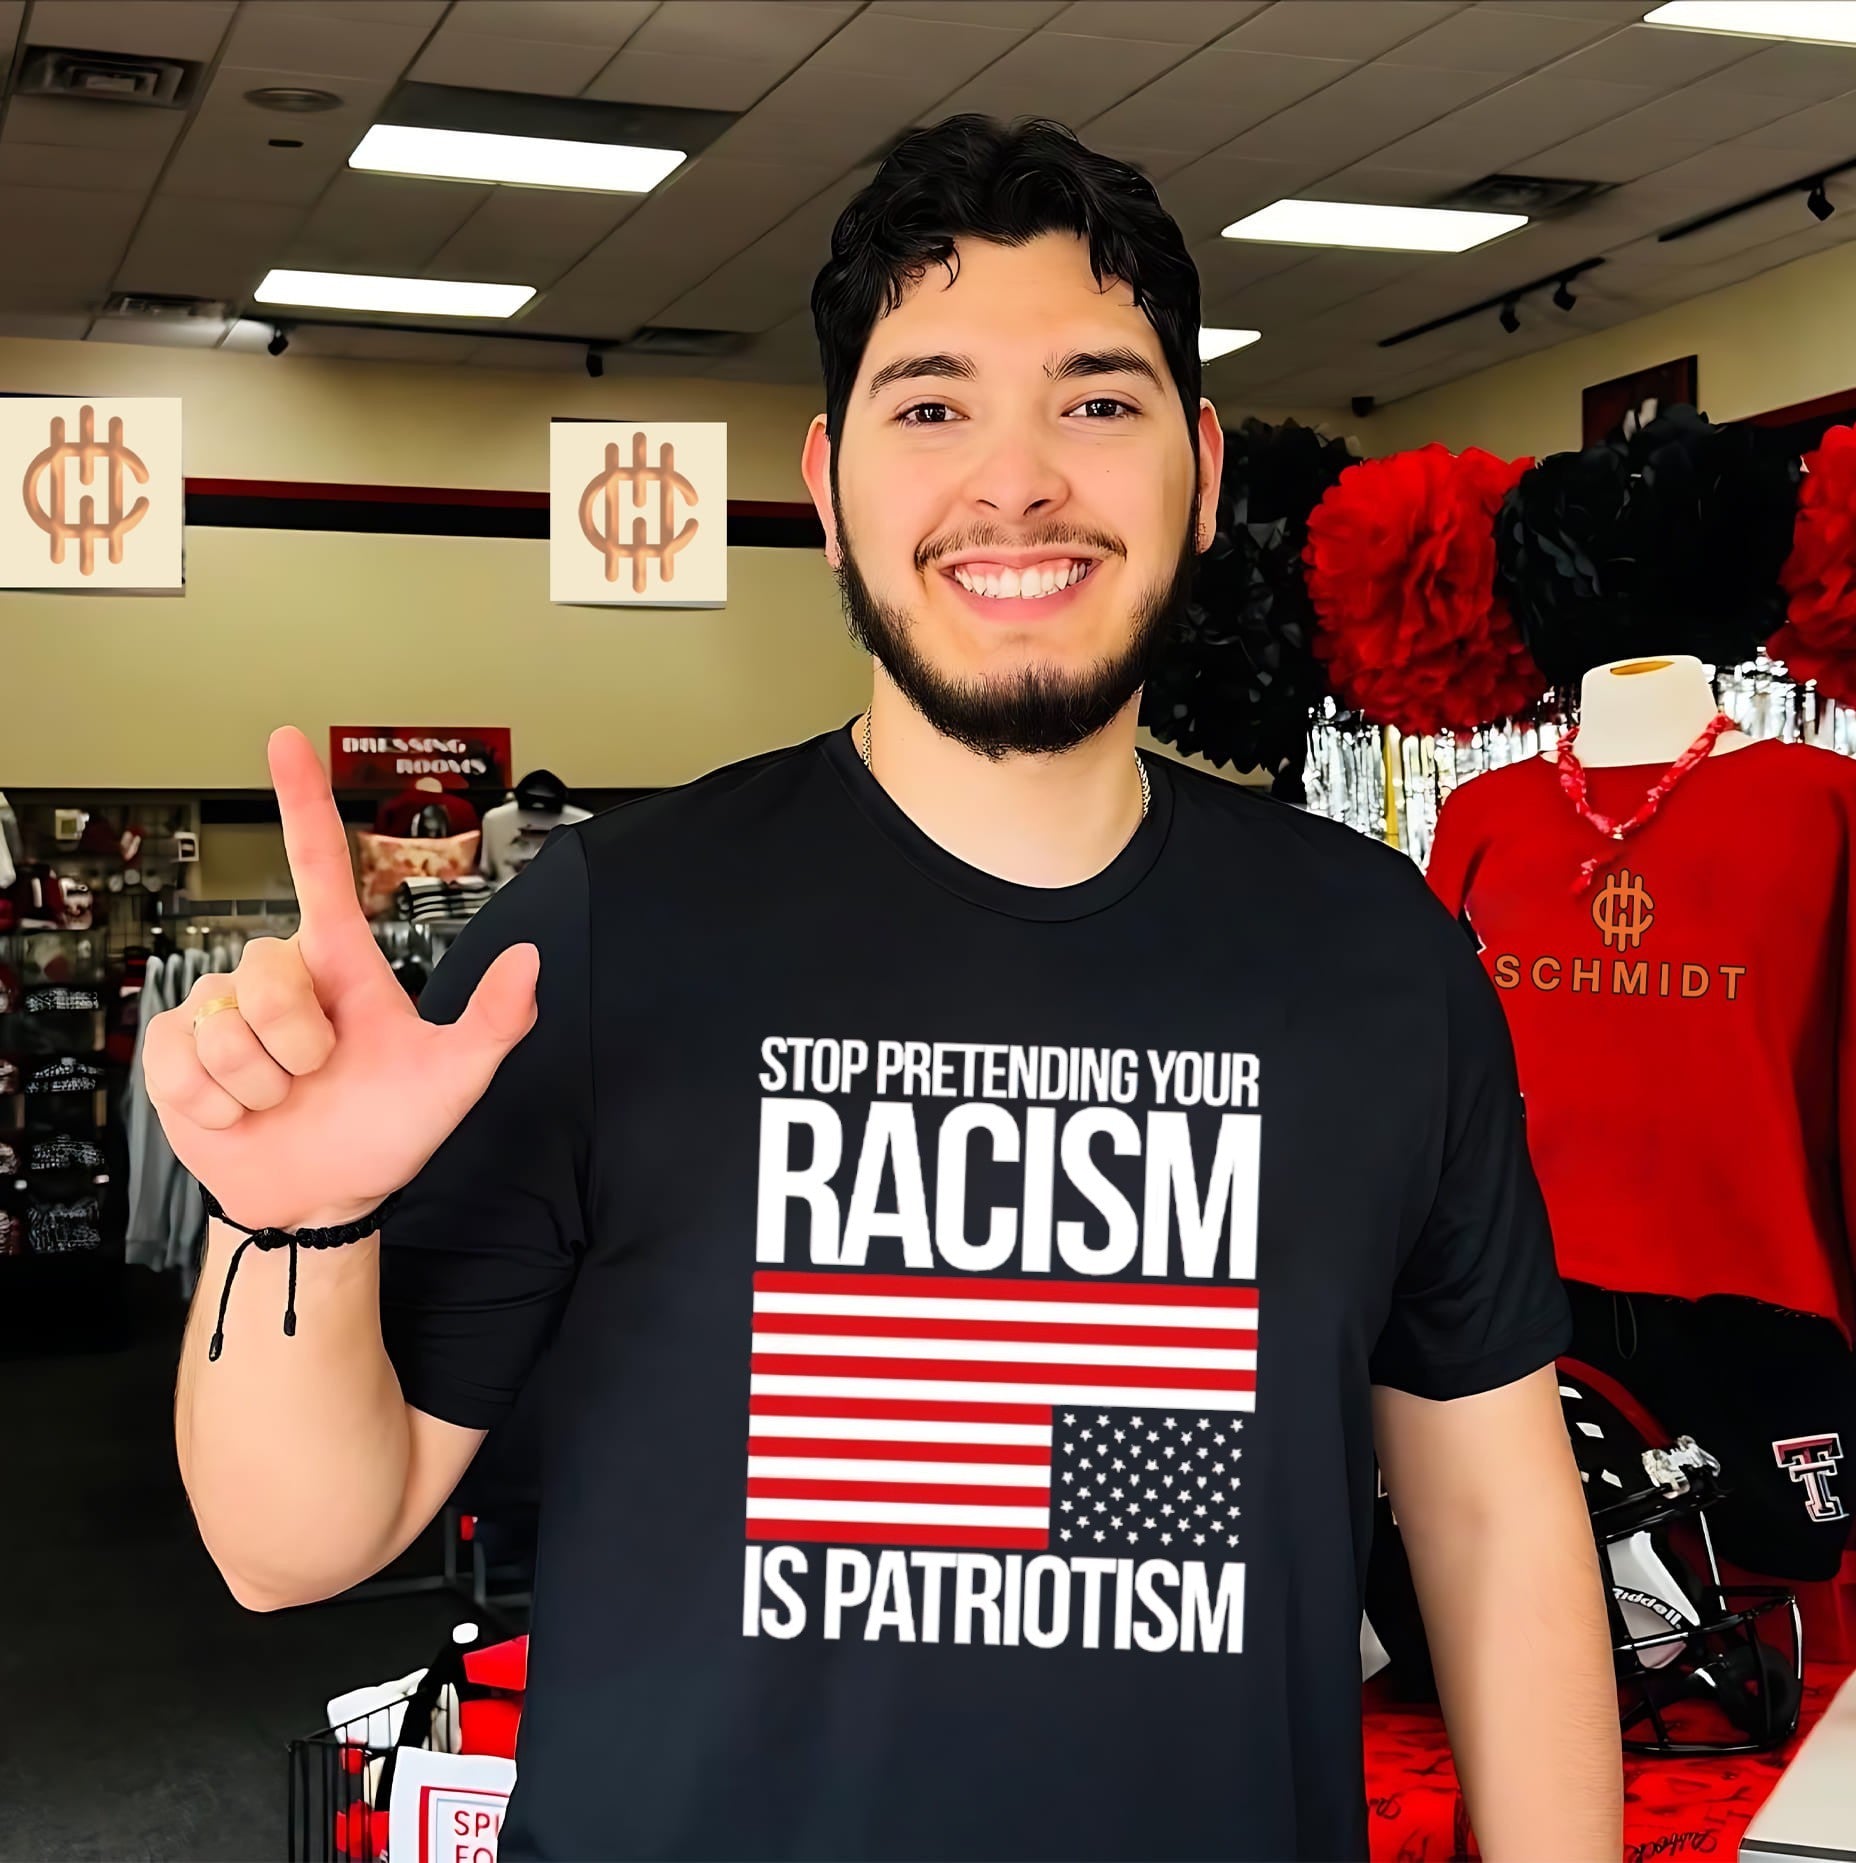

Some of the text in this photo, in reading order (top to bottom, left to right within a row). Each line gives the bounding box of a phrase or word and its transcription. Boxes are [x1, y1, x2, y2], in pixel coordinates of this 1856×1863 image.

[396, 758, 487, 775] ROOMS
[1494, 954, 1747, 1000] SCHMIDT
[759, 1036, 1261, 1108] STOP PRETENDING YOUR
[756, 1096, 1262, 1280] RACISM
[742, 1545, 1246, 1654] IS PATRIOTISM
